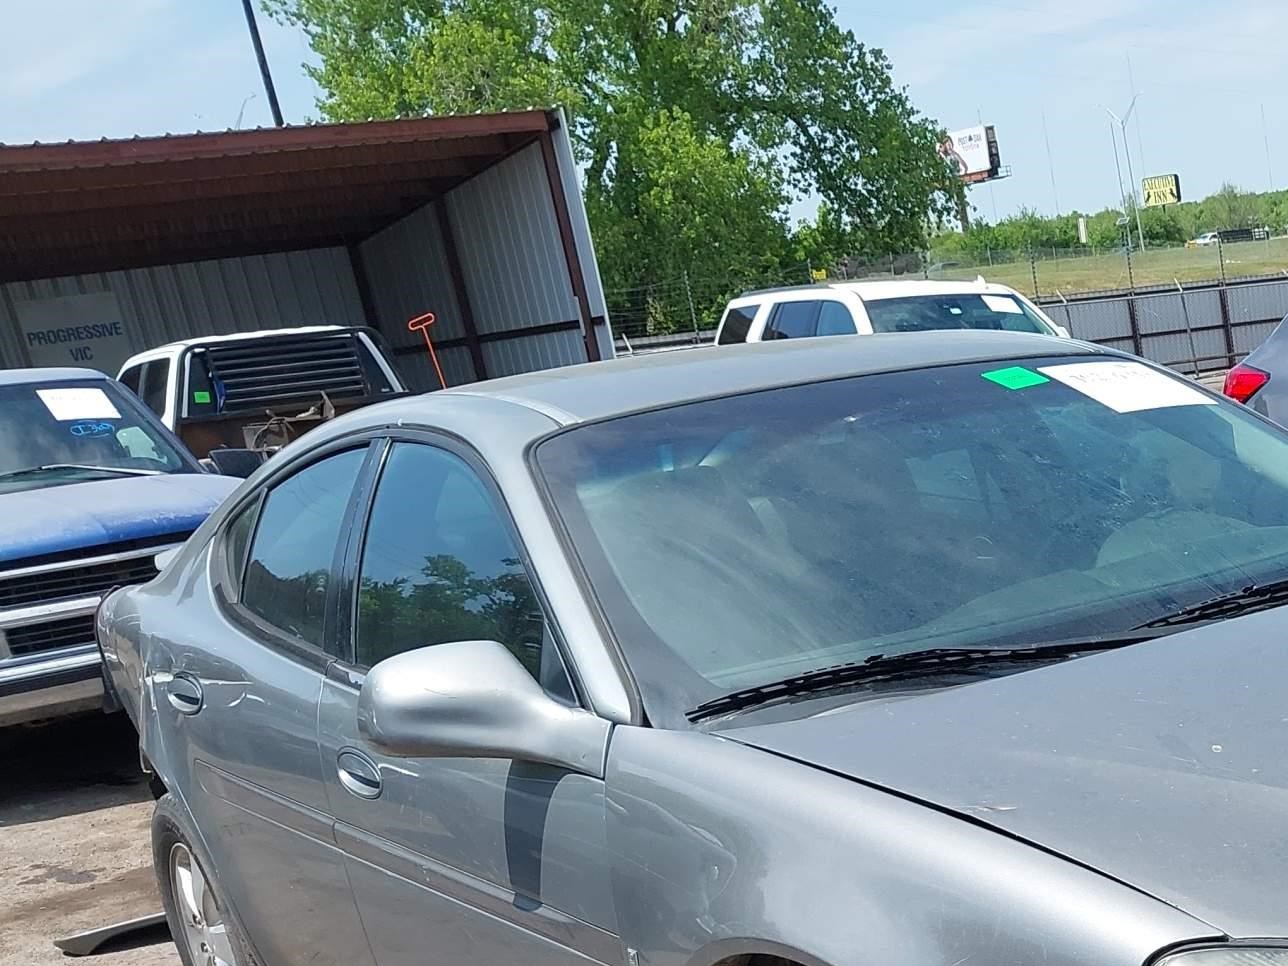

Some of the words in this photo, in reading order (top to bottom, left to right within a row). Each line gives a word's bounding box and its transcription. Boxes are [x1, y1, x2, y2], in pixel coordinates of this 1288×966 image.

[1153, 190, 1169, 204] INN
[26, 321, 123, 347] PROGRESSIVE
[69, 346, 94, 362] VIC
